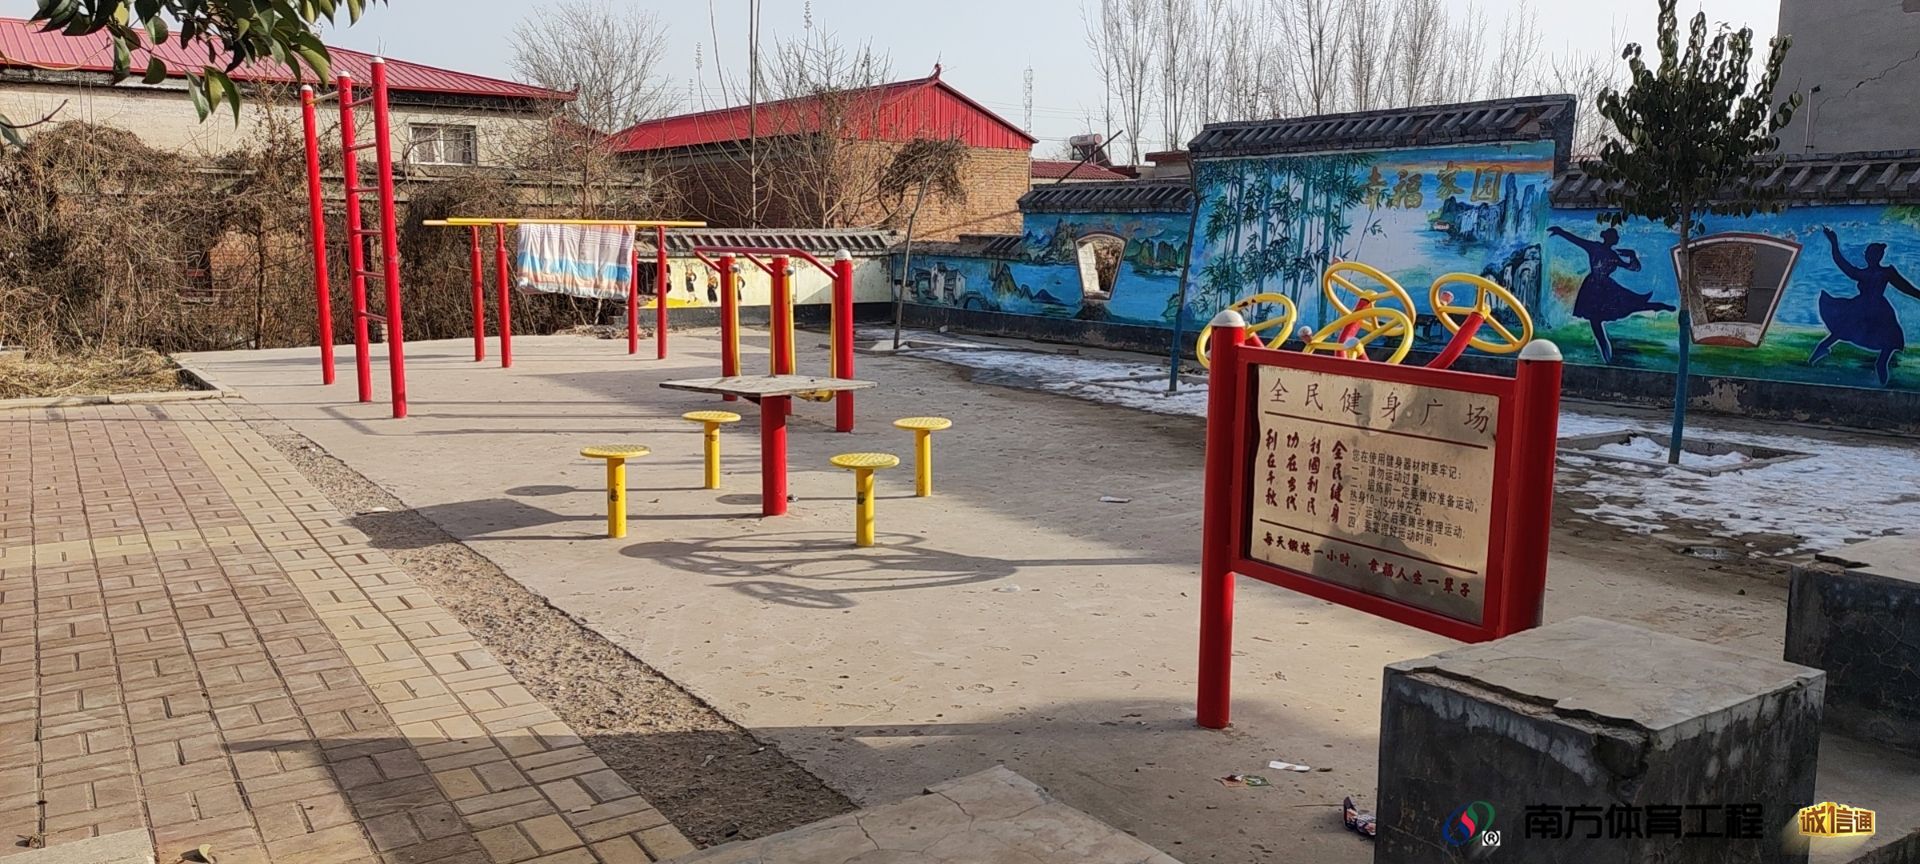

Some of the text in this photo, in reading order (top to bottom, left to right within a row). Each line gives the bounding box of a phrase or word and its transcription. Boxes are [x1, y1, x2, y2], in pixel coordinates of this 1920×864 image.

[1270, 377, 1489, 434] 全民健身广场
[1265, 428, 1278, 507] 利在千秋
[1285, 431, 1300, 511] 功在当代
[1330, 440, 1348, 523] 全民健身
